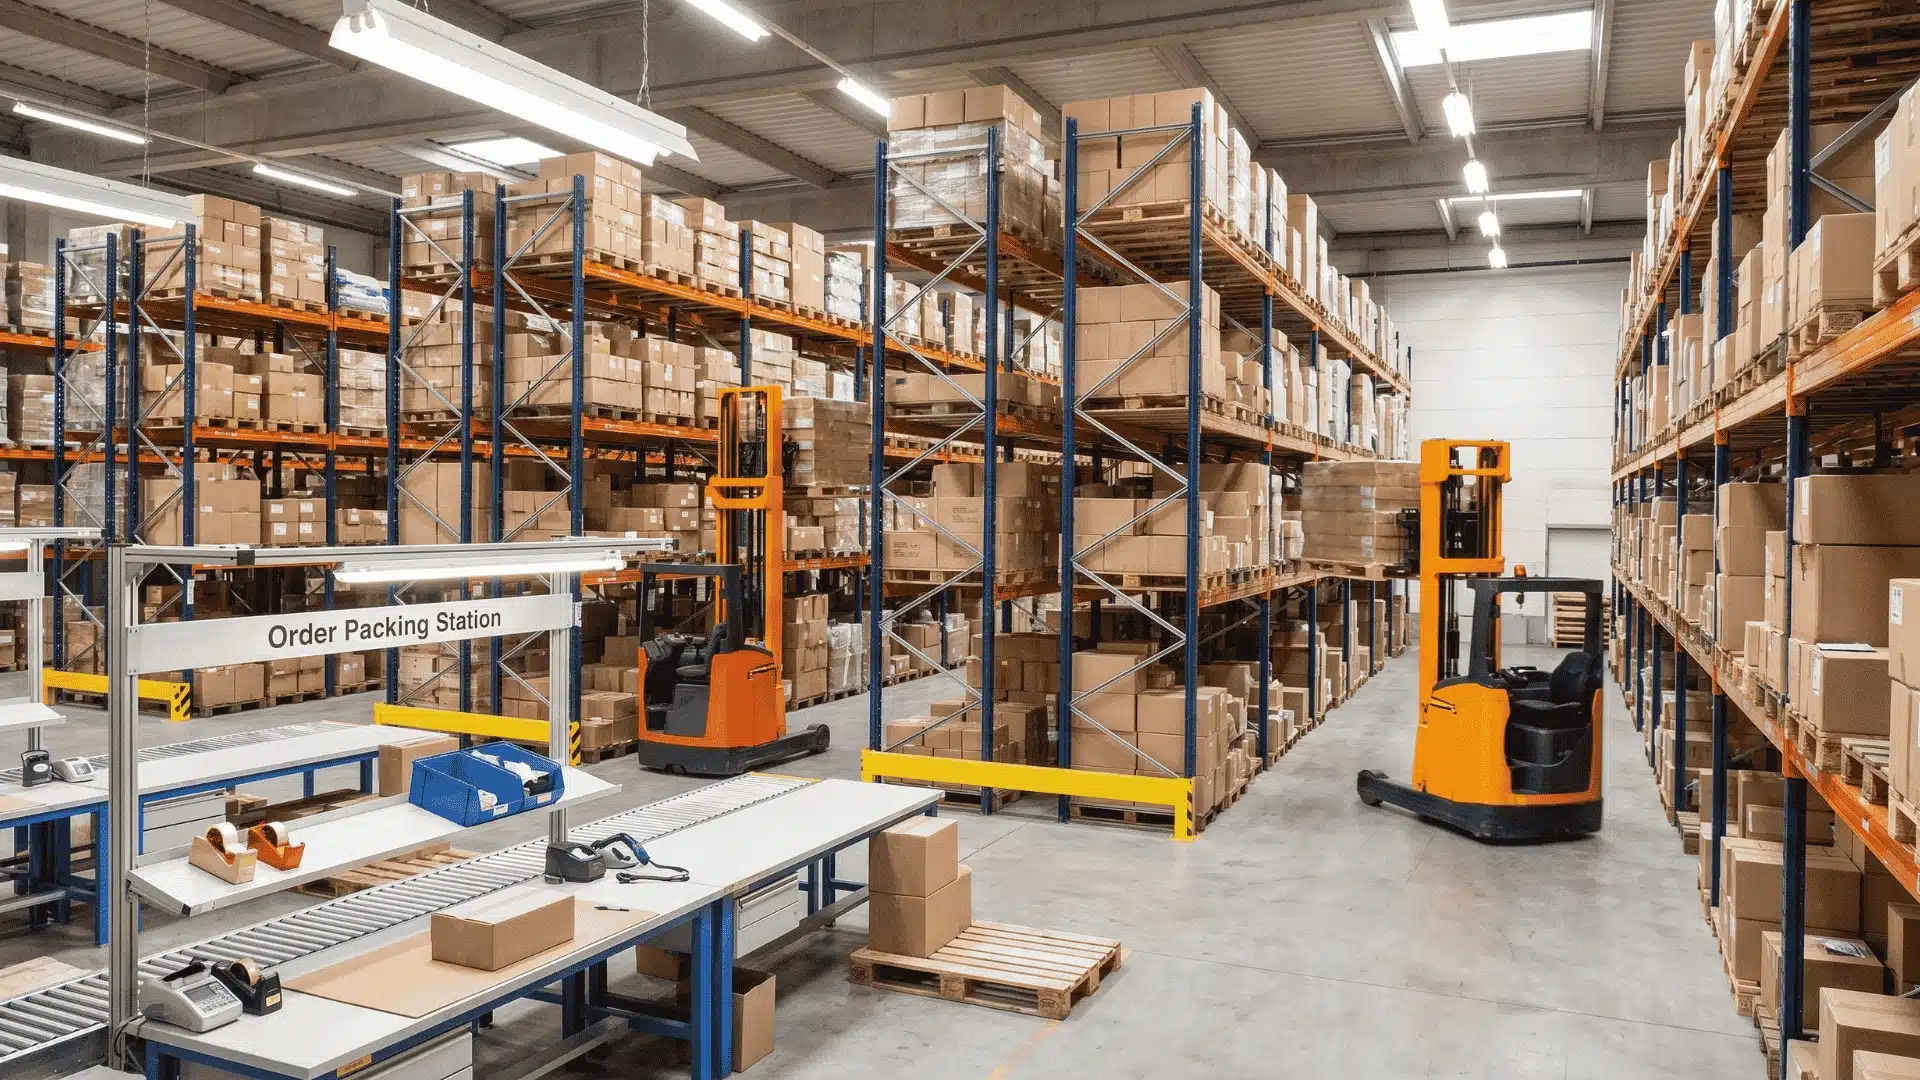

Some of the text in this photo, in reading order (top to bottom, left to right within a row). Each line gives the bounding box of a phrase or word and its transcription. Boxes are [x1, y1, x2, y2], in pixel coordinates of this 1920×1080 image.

[268, 611, 501, 649] Order Packing Station
